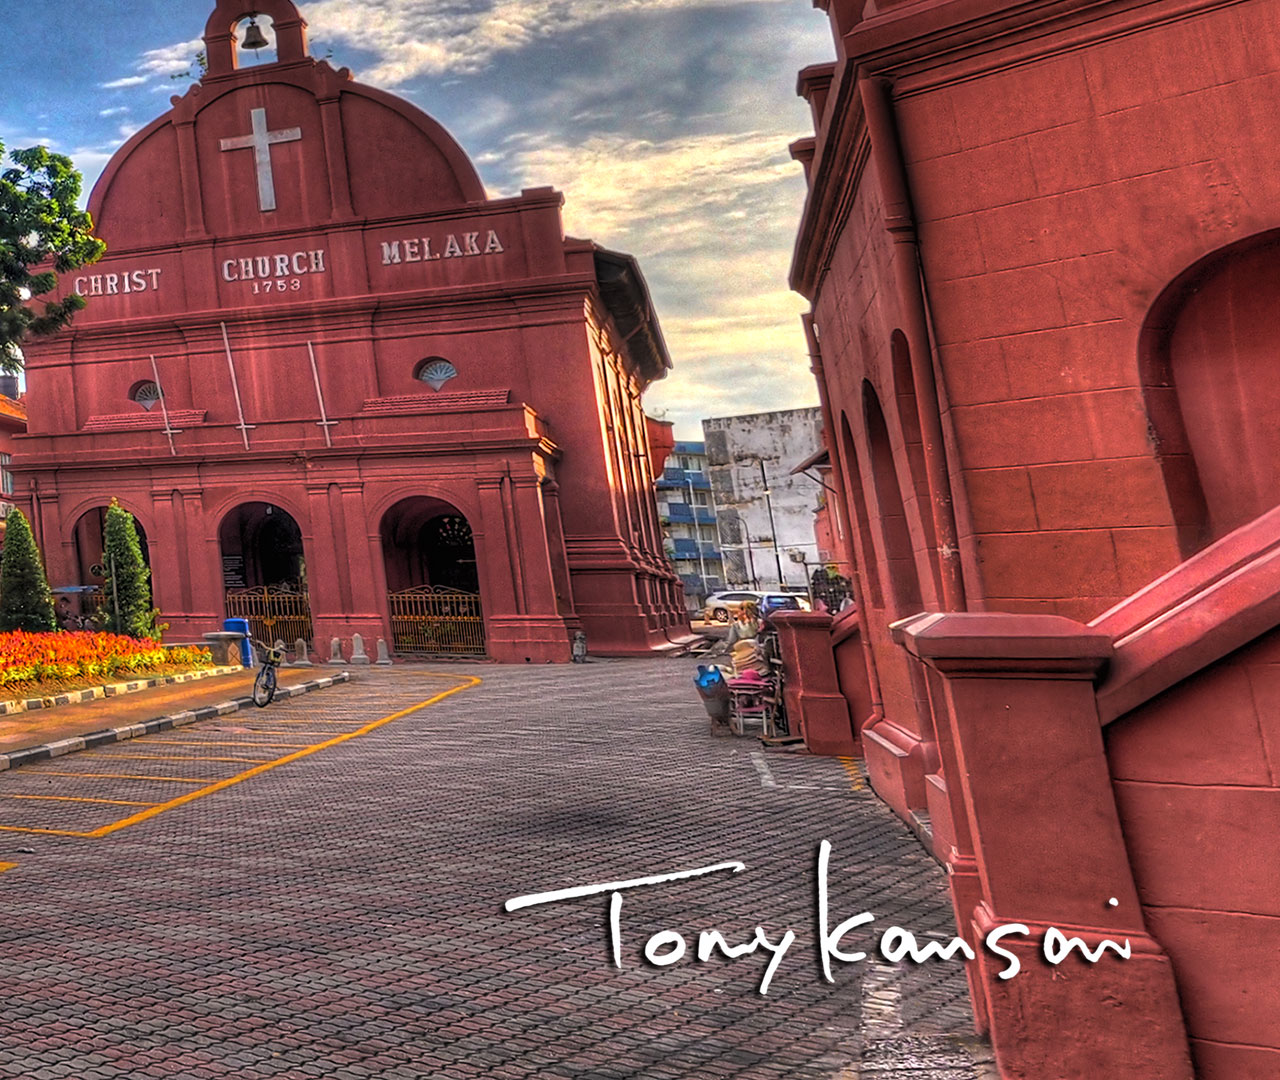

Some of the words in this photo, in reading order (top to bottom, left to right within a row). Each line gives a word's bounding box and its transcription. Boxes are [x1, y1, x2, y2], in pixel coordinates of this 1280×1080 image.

[74, 268, 161, 297] CHRIST
[222, 250, 325, 282] CHURCH
[380, 229, 504, 265] MELAKA
[252, 278, 301, 294] 1753
